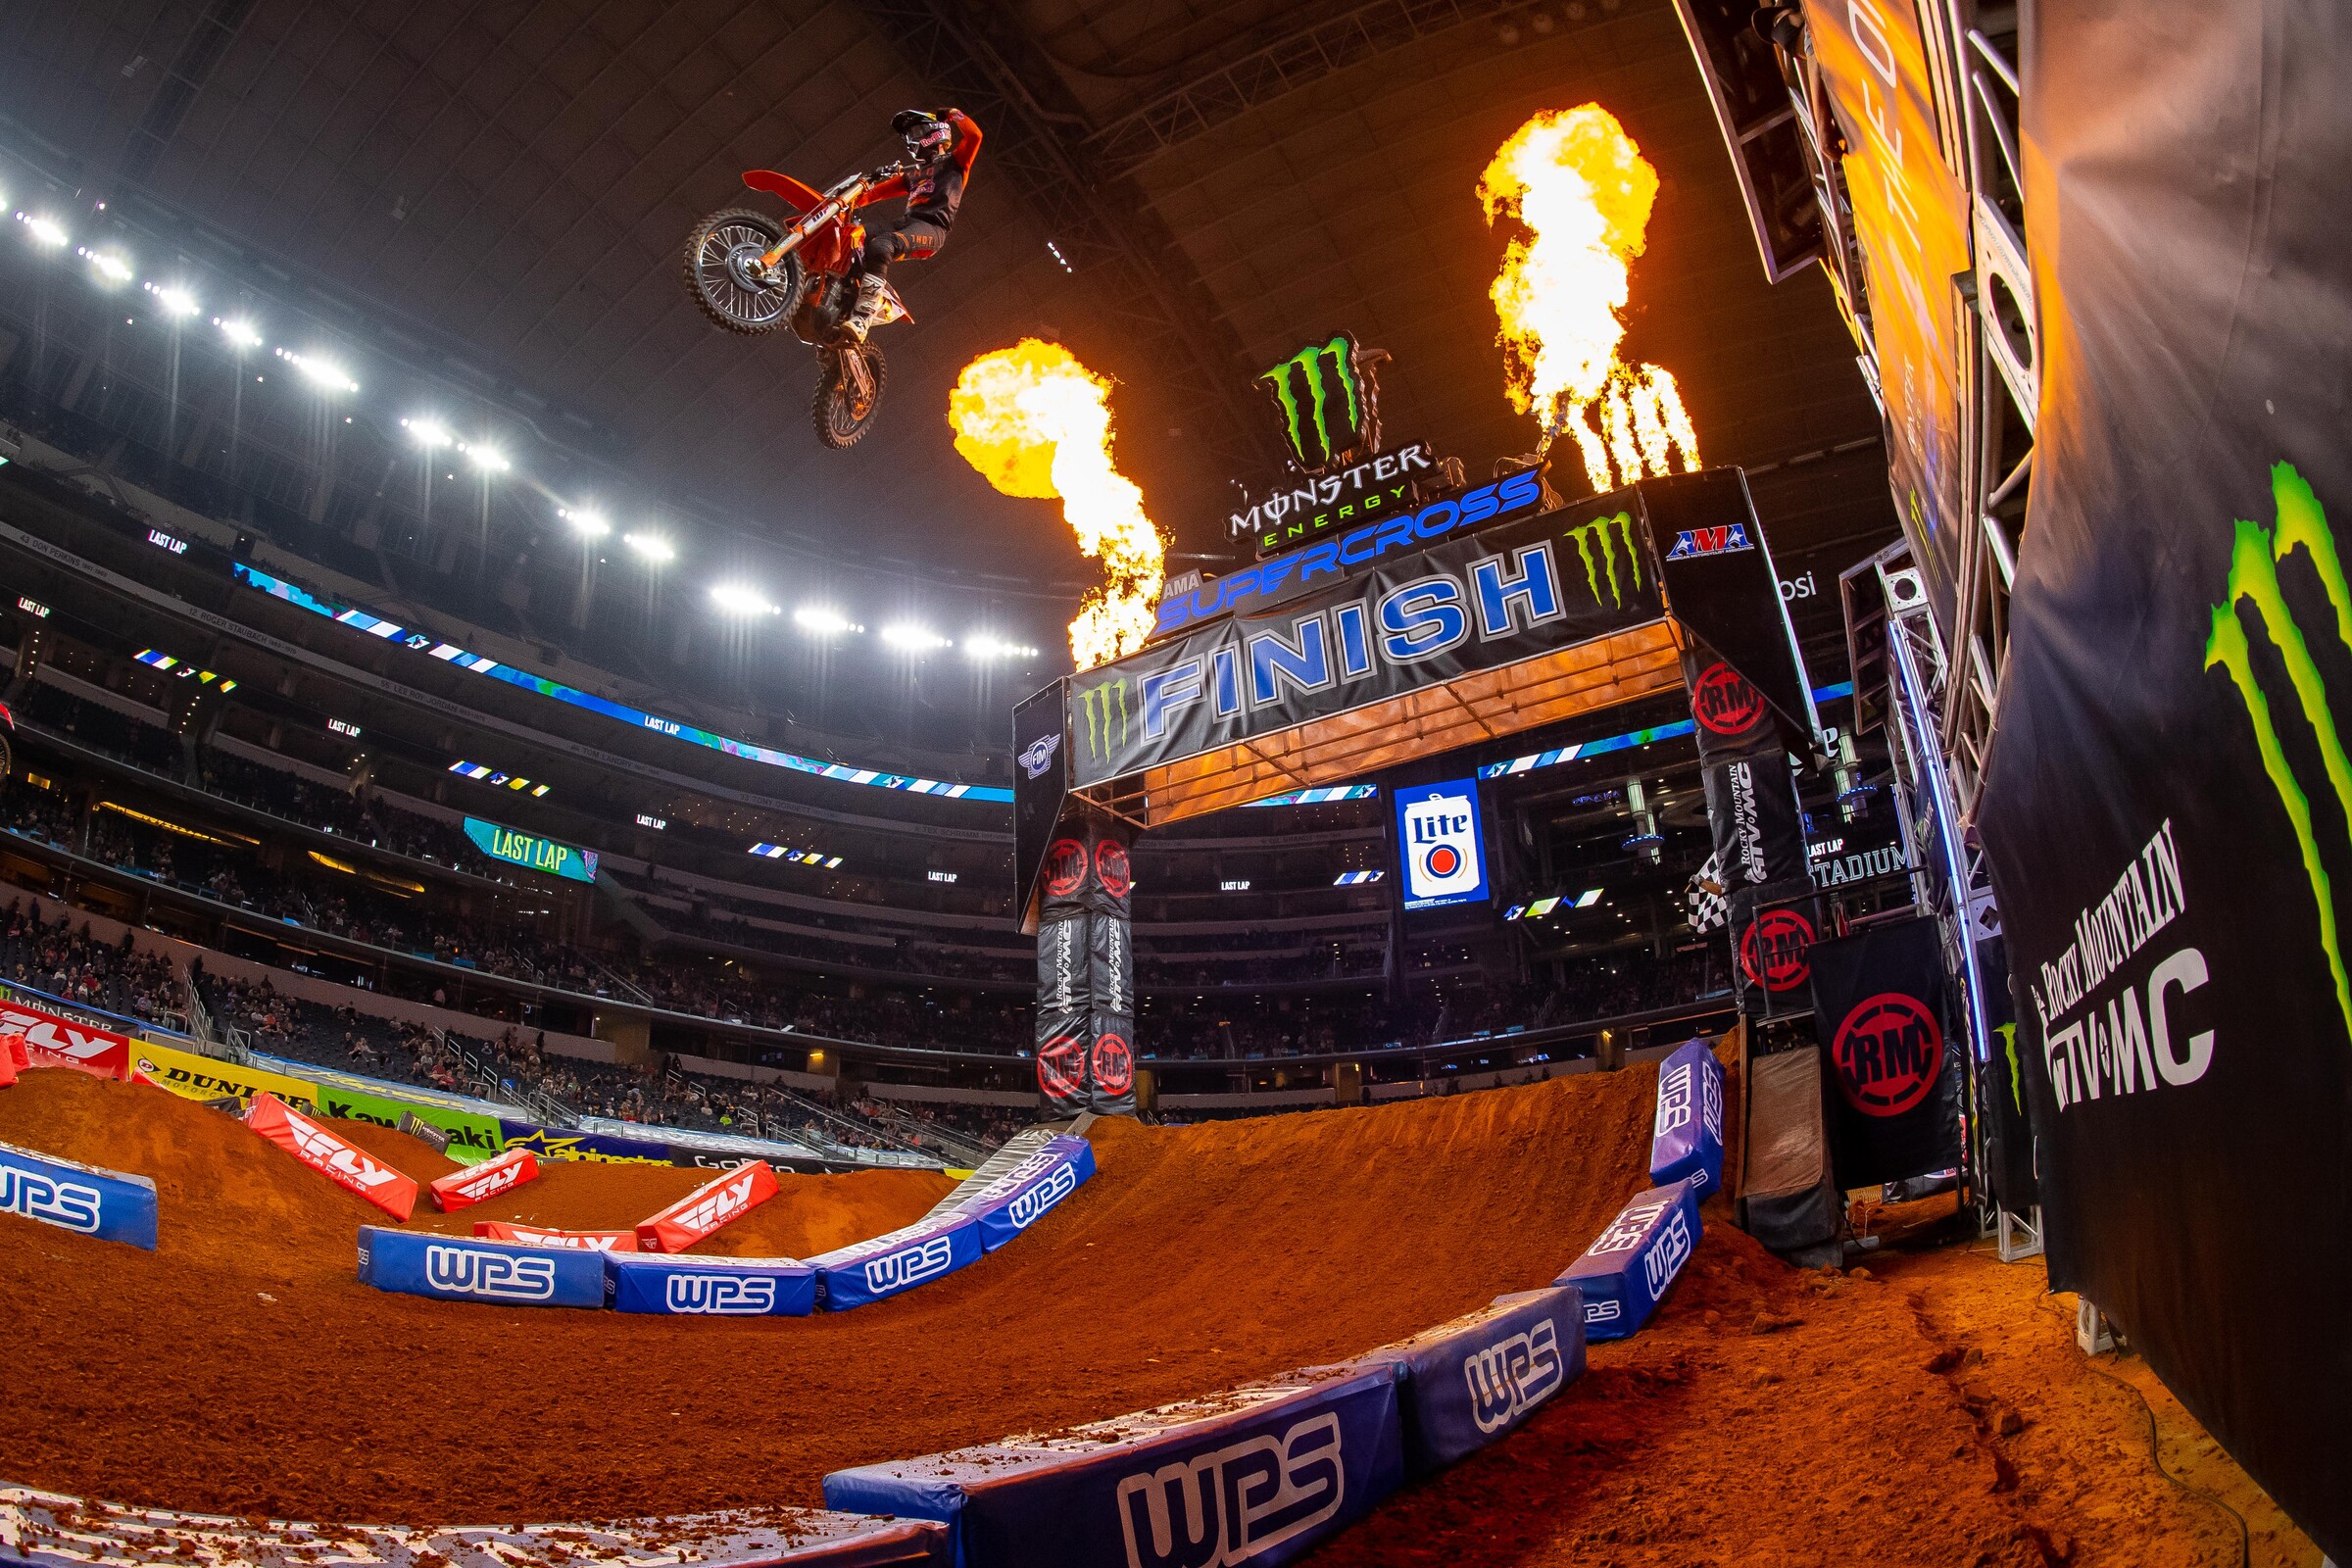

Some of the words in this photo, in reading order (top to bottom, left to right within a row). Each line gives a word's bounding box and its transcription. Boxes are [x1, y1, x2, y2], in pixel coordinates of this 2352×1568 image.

[1228, 444, 1431, 536] MONSTER
[1264, 485, 1405, 548] ENERGY
[32, 539, 48, 552] DON
[49, 547, 81, 566] PERKINS
[148, 529, 170, 549] LAST
[170, 536, 188, 555] LAP
[1155, 469, 1540, 635] SUPERCROSS
[1666, 523, 1753, 558] AMA
[1163, 568, 1200, 600] AMA
[19, 597, 36, 614] LAST
[35, 604, 51, 619] LAP
[200, 612, 227, 627] ROGER
[228, 622, 268, 644] STAUBACH
[1138, 539, 1567, 749] FINISH
[393, 686, 408, 695] LEE
[409, 690, 425, 700] ROY
[426, 697, 459, 712] JORDAN
[328, 718, 346, 734] LAST
[346, 724, 362, 737] LAP
[644, 715, 664, 732] LAST
[665, 721, 680, 735] LAP
[582, 747, 600, 758] TOM
[602, 753, 632, 767] LANDRY
[1729, 764, 1746, 825] MOUNTAIN
[636, 812, 653, 828] LAST
[653, 817, 666, 830] LAP
[940, 828, 980, 838] SCHRAMM
[1412, 814, 1467, 845] Lite
[491, 828, 534, 863] LAST
[535, 836, 569, 872] LAP
[1740, 827, 1751, 865] ROCKY
[1807, 842, 1826, 858] LAST
[1827, 838, 1844, 854] LAP
[928, 871, 944, 882] LAST
[945, 872, 957, 883] LAP
[1221, 881, 1238, 890] LAST
[1238, 881, 1250, 890] LAP
[1809, 846, 1907, 888] TADIUM
[2040, 942, 2082, 1021] ROCKY
[2075, 816, 2184, 993] MOUNTAIN
[1763, 934, 1802, 968] RM
[1854, 1023, 1923, 1085] RM
[283, 1110, 398, 1187] FLY
[298, 1149, 371, 1194] RACING
[457, 1160, 523, 1199] FLY
[474, 1181, 514, 1202] RACING
[672, 1172, 755, 1231] FLY
[1007, 1160, 1076, 1230] WPS
[700, 1201, 749, 1235] RACING
[425, 1245, 556, 1300] WPS
[865, 1235, 953, 1295] WPS
[1643, 1208, 1691, 1301] WPS
[666, 1273, 776, 1314] WPS
[1464, 1317, 1565, 1435] WPS
[1117, 1411, 1346, 1568] WPS
